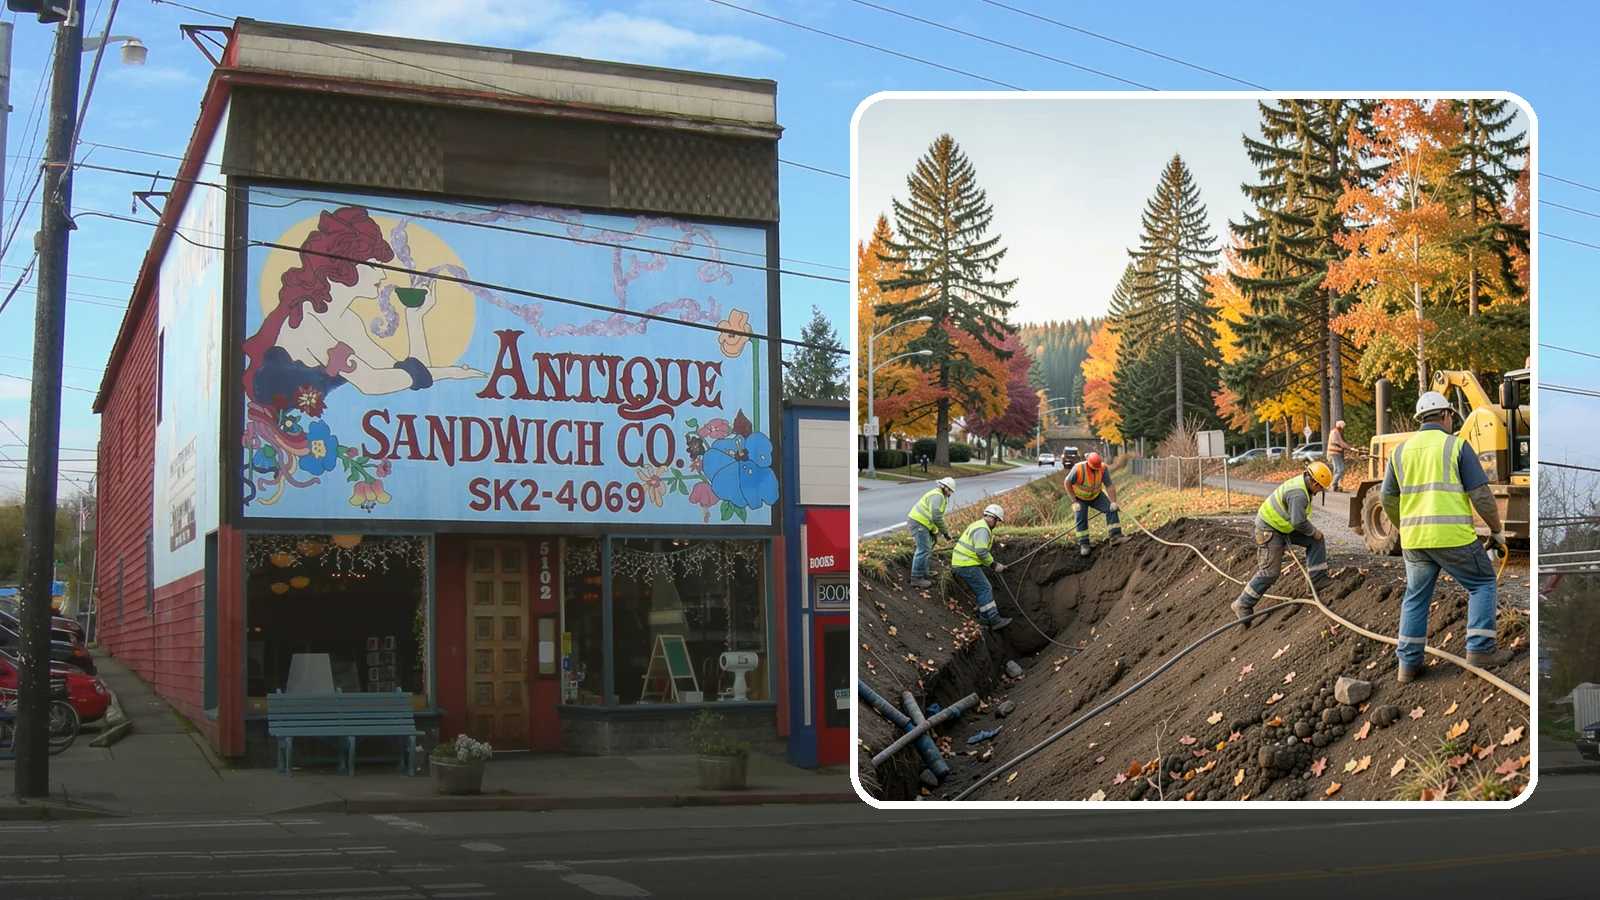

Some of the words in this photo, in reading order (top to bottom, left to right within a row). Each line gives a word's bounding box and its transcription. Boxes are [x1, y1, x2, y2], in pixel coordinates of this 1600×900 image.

[476, 329, 724, 421] ANTIQUE
[361, 408, 605, 468] SANDWICH
[617, 421, 685, 469] CO.
[468, 476, 646, 513] SK2-4069
[540, 541, 551, 600] 5102
[809, 555, 835, 569] BOOKS
